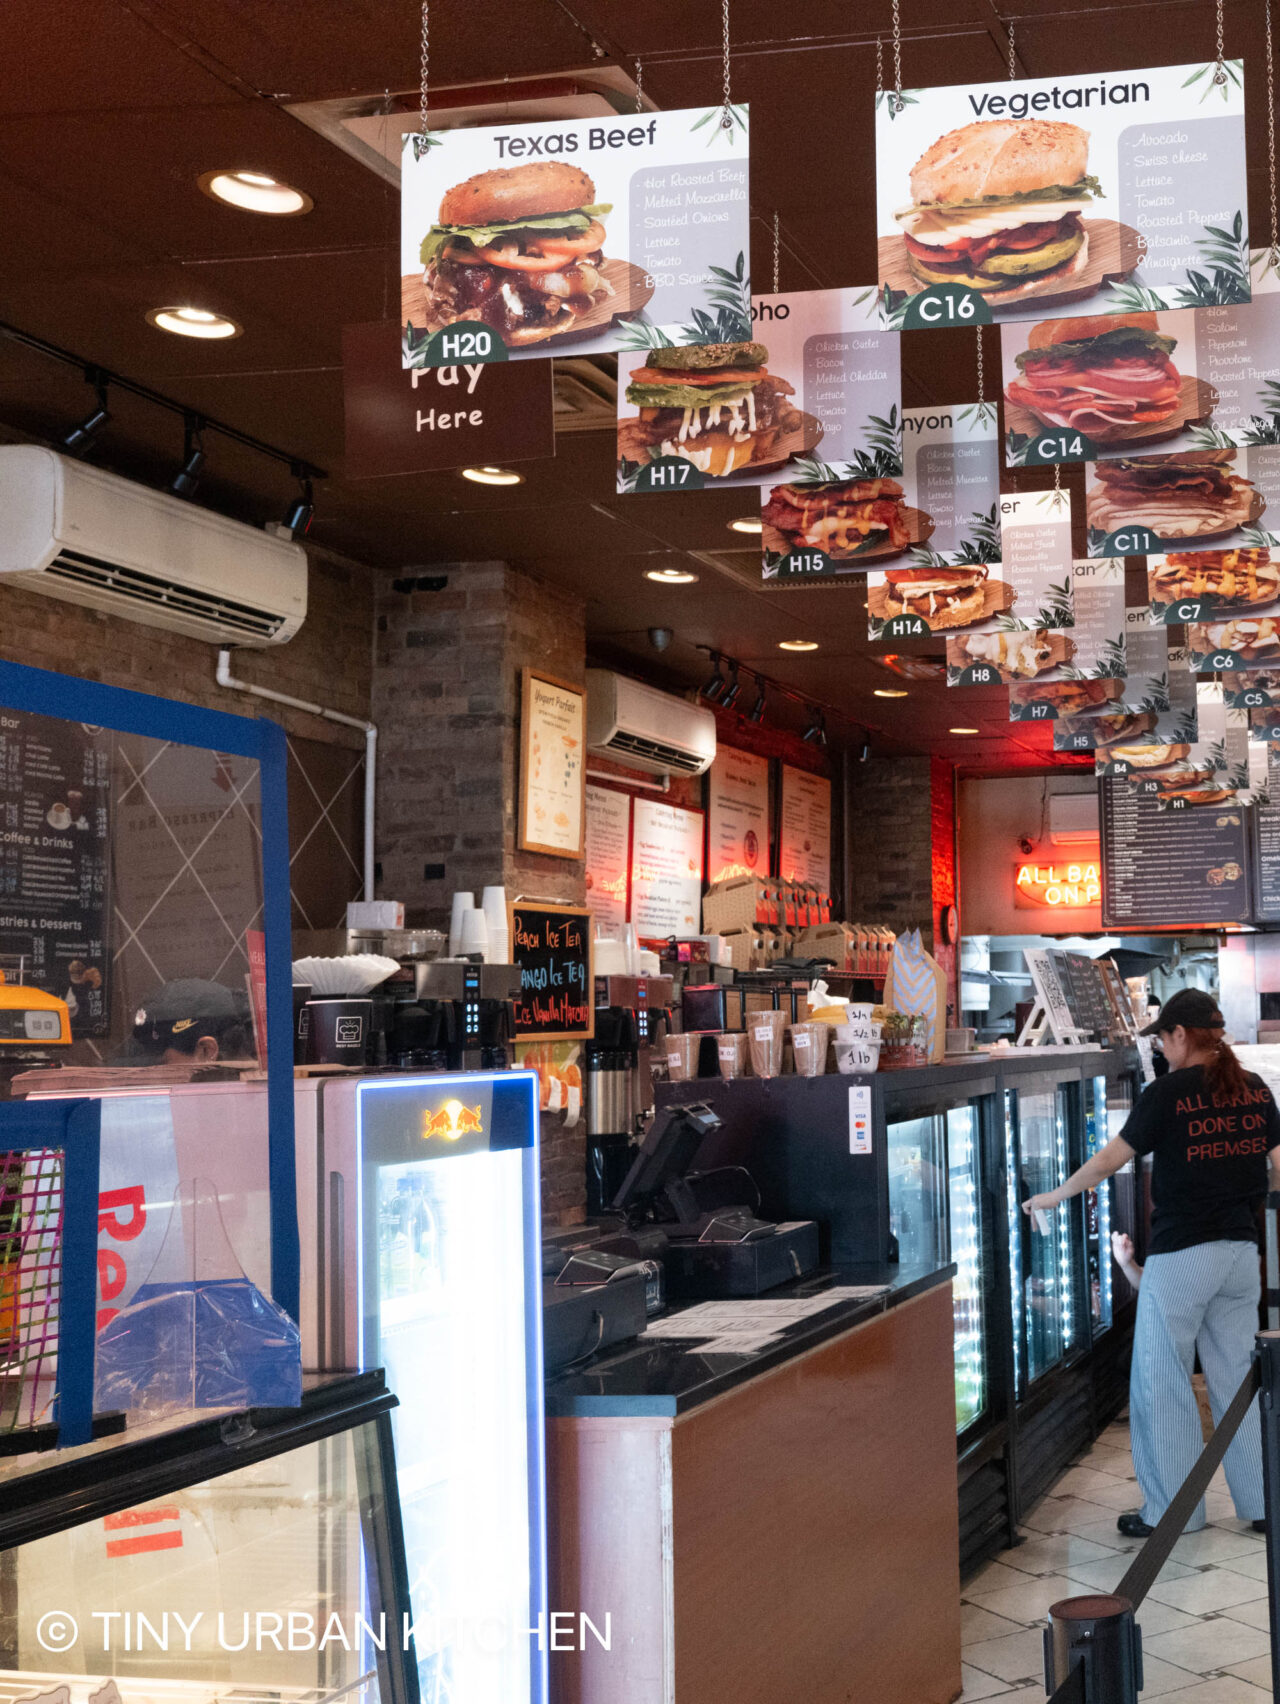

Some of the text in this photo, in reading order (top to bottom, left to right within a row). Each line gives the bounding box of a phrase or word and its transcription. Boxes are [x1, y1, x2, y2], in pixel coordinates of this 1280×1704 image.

[968, 80, 1151, 119] Vegetarian
[493, 120, 657, 158] Texas Beef
[1132, 131, 1188, 147] Avocado
[1134, 150, 1209, 167] Swiss cheese
[643, 168, 746, 189] Hot Roasted Beef
[1135, 175, 1174, 188] Lettuce
[643, 188, 747, 211] Melted Mozzarella
[1134, 193, 1175, 208] Tomato
[692, 211, 729, 224] Onions
[1136, 210, 1231, 228] Roasted Peppers
[645, 237, 681, 248] Lettuce
[1136, 234, 1191, 249] Balsamic
[643, 254, 681, 269] Tomato
[1136, 254, 1202, 271] Vinaigrette
[643, 272, 714, 289] BBQ Sauce
[919, 292, 976, 322] C16
[1207, 323, 1238, 334] Salami
[442, 332, 491, 358] H20
[815, 338, 880, 353] Chicken Cutlet
[1208, 338, 1247, 352] Pepperoni
[815, 357, 844, 368] Bacon
[1208, 355, 1252, 367] Provolone
[815, 369, 887, 386] Melted Cheddar
[1209, 368, 1280, 383] Roasted Peppers
[816, 390, 846, 401] Lettuce
[1210, 390, 1239, 400] Lettuce
[816, 405, 847, 416] Tomato
[1210, 404, 1241, 416] Tomato
[416, 408, 483, 433] Here
[816, 420, 842, 435] Mayo
[1038, 436, 1083, 458] C14
[650, 465, 690, 486] H17
[1114, 533, 1150, 551] C11
[789, 554, 824, 572] H15
[1178, 604, 1201, 620] C7
[893, 620, 923, 635] H14
[1212, 655, 1234, 668] C6
[972, 669, 990, 682] H8
[1244, 693, 1263, 705] C5
[1032, 706, 1048, 718] H7
[1, 717, 20, 728] Bar
[1073, 737, 1089, 748] H5
[1144, 782, 1158, 792] H3
[1173, 799, 1185, 808] H1
[34, 836, 40, 845] &
[42, 837, 74, 849] Drinks
[1016, 866, 1061, 885] ALL
[1045, 886, 1079, 905] ON
[31, 919, 38, 928] &
[40, 919, 82, 930] Desserts
[519, 960, 547, 990] ANGO
[848, 1050, 871, 1065] 1 lb
[1176, 1093, 1209, 1115] ALL
[1188, 1116, 1238, 1137] DONE
